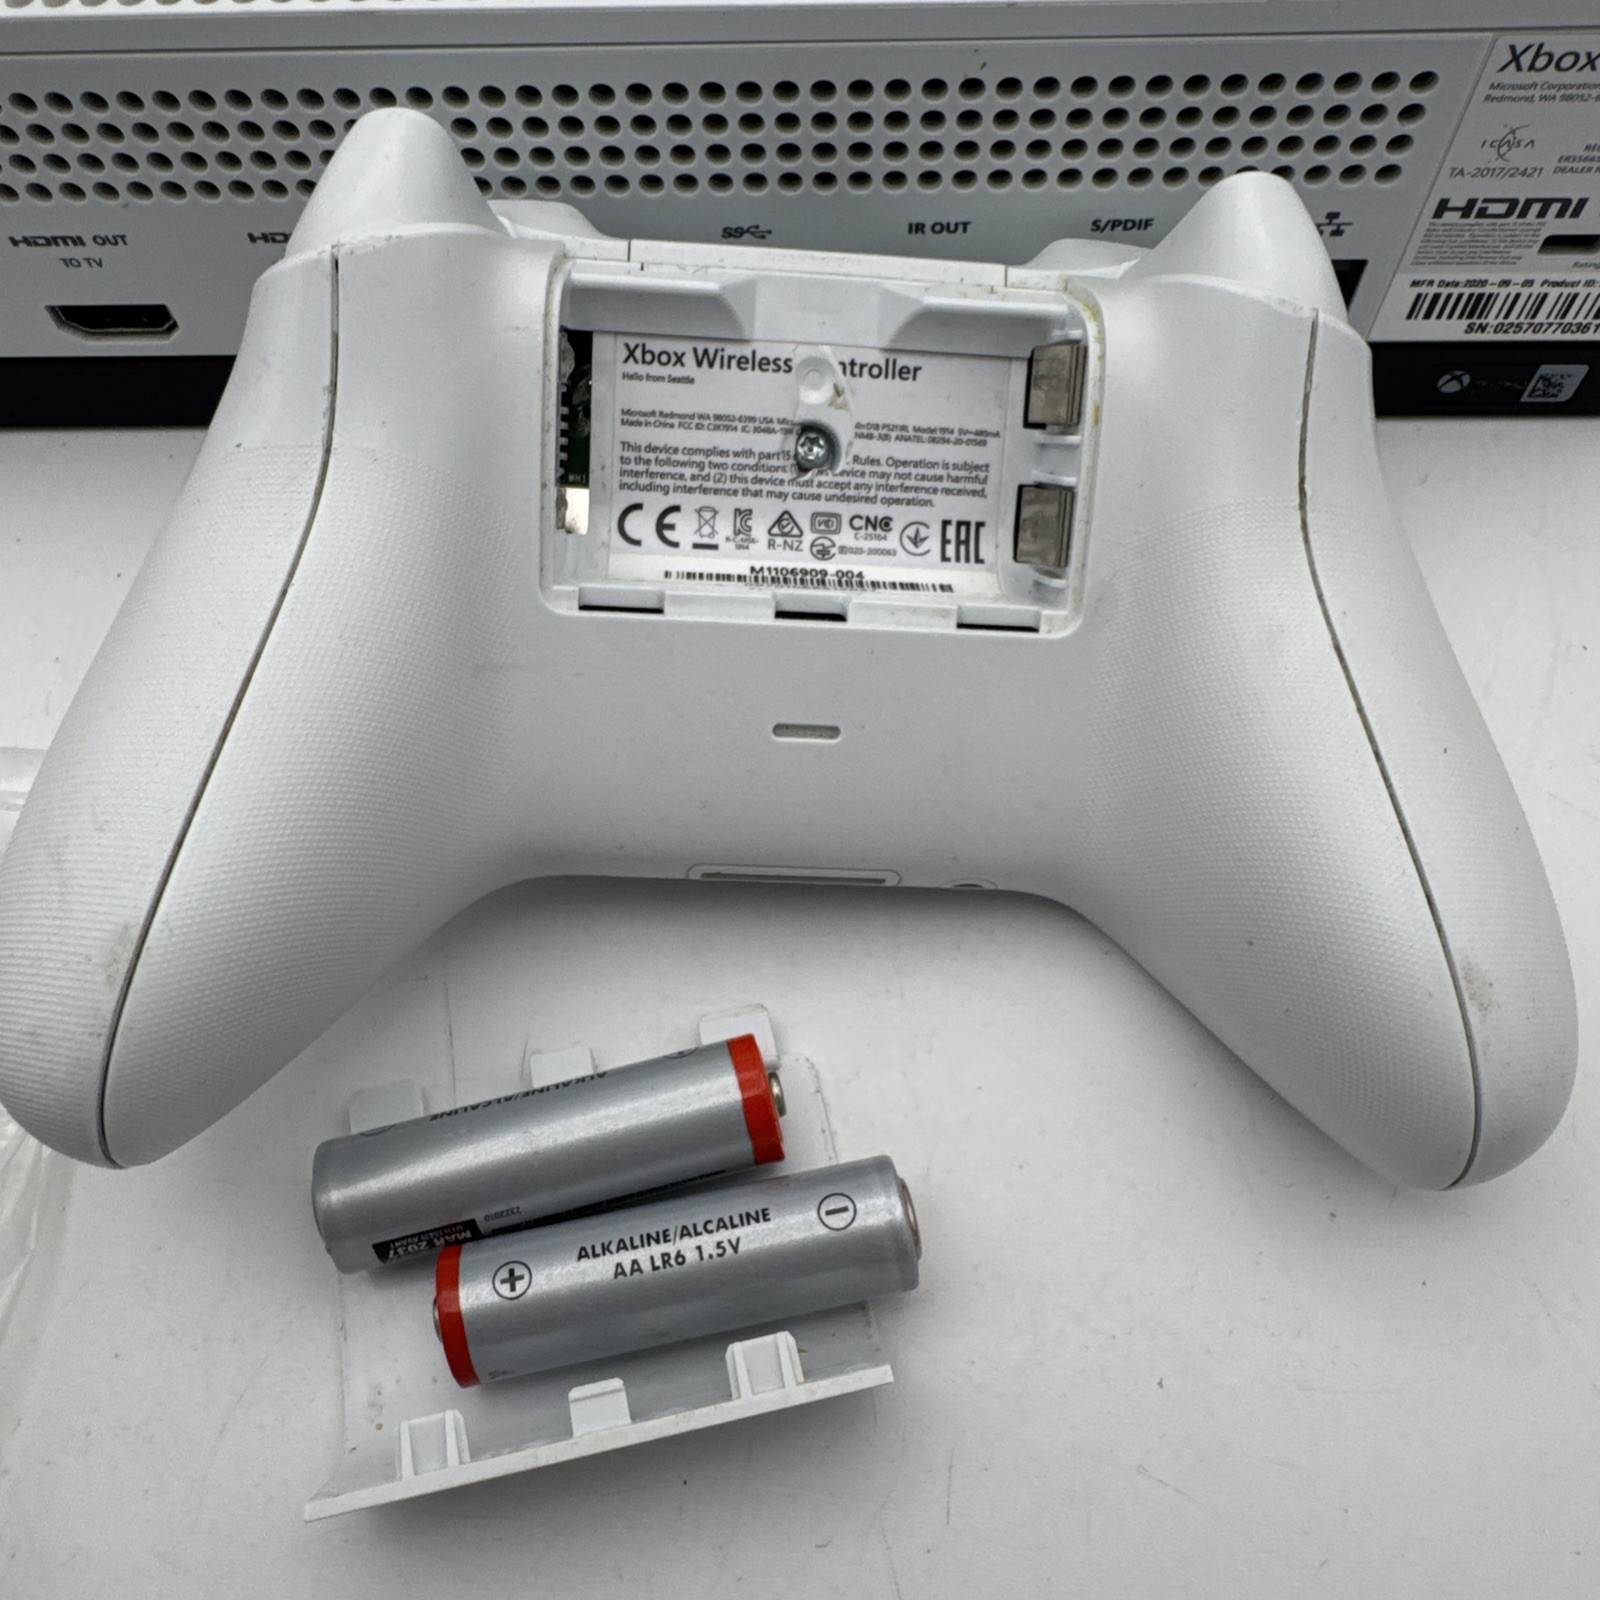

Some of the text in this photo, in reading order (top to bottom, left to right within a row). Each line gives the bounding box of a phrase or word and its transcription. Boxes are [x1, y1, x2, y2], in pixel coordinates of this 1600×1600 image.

[1497, 42, 1600, 73] Xbox
[1488, 82, 1538, 92] Microsoft
[1538, 93, 1558, 102] WA
[1449, 167, 1544, 179] TA-2017/2421
[1552, 166, 1594, 174] DEALER
[1431, 197, 1590, 220] HDMI
[908, 221, 971, 235] IR OUT
[1090, 217, 1154, 234] S/PDIF
[8, 234, 128, 247] HDMI OUT
[60, 257, 104, 268] TO TV
[1410, 279, 1434, 288] MFR
[1540, 279, 1581, 288] Product
[622, 343, 922, 382] Xbox Wireless ntroller
[622, 372, 695, 385] Hello from Seattle
[621, 418, 642, 427] Made
[644, 419, 652, 428] in
[653, 420, 675, 429] China
[678, 421, 694, 430] FCC
[620, 441, 791, 463] This device complies with part 15
[620, 455, 632, 465] to
[634, 455, 652, 466] the
[654, 455, 706, 472] following
[707, 460, 729, 470] two
[852, 455, 990, 475] Rules. Operation is subject
[619, 467, 987, 499] interference, and (2) this device must accept any interference received,
[868, 470, 892, 482] may
[894, 471, 912, 481] not
[914, 473, 944, 483] cause
[946, 472, 988, 485] harmful
[619, 479, 935, 507] including interference that may cause undesired operation.
[617, 502, 681, 549] CE
[767, 538, 803, 552] R-NZ
[941, 519, 986, 564] EAC
[750, 565, 865, 580] M1106909-004
[577, 1207, 772, 1262] ALKALINE/ALCALINE
[613, 1236, 741, 1280] AA LR6 1.5V
